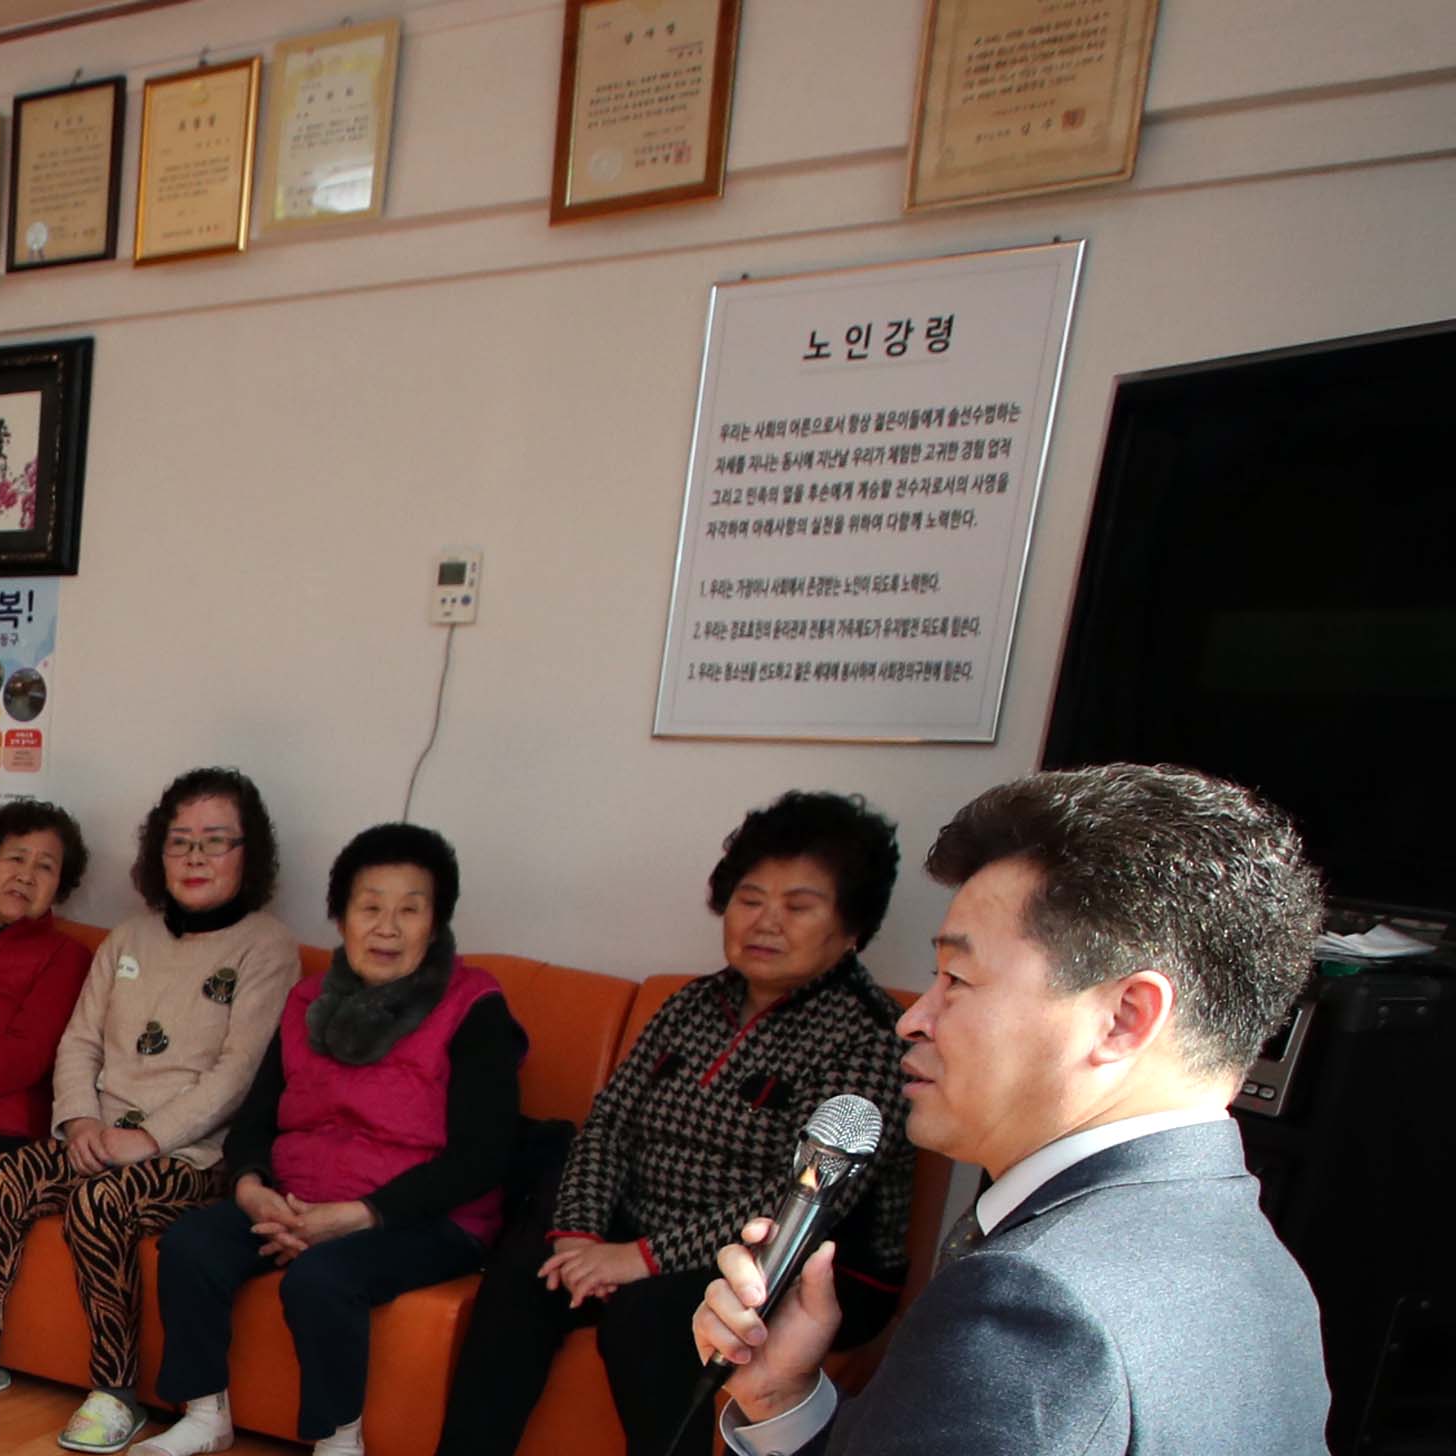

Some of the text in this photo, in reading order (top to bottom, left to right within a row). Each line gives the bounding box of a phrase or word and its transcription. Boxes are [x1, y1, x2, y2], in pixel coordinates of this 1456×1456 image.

[802, 313, 955, 361] 노인강령
[720, 423, 751, 442] 우리는
[754, 418, 787, 439] 사회의
[789, 414, 846, 438] 어른으로서
[874, 407, 946, 432] 젊은이들에게
[947, 400, 1022, 427] 솔선수범하는
[714, 454, 746, 475] 자세를
[782, 450, 814, 471] 동시에
[817, 447, 850, 468] 지난날
[852, 446, 885, 465] 우리가
[888, 443, 922, 464] 체험한
[924, 440, 959, 461] 고귀한
[710, 487, 743, 506] 그리고
[746, 485, 779, 505] 민족의
[808, 480, 855, 502] 후손에게
[896, 474, 969, 498] 전수자로서의
[971, 471, 1009, 494] 사명을
[811, 514, 845, 536] 실천을
[926, 508, 978, 530] 노력한다.
[710, 579, 733, 599] 우리는
[0, 633, 20, 647] 동구
[704, 621, 728, 640] 우리는
[699, 662, 722, 682] 우리는
